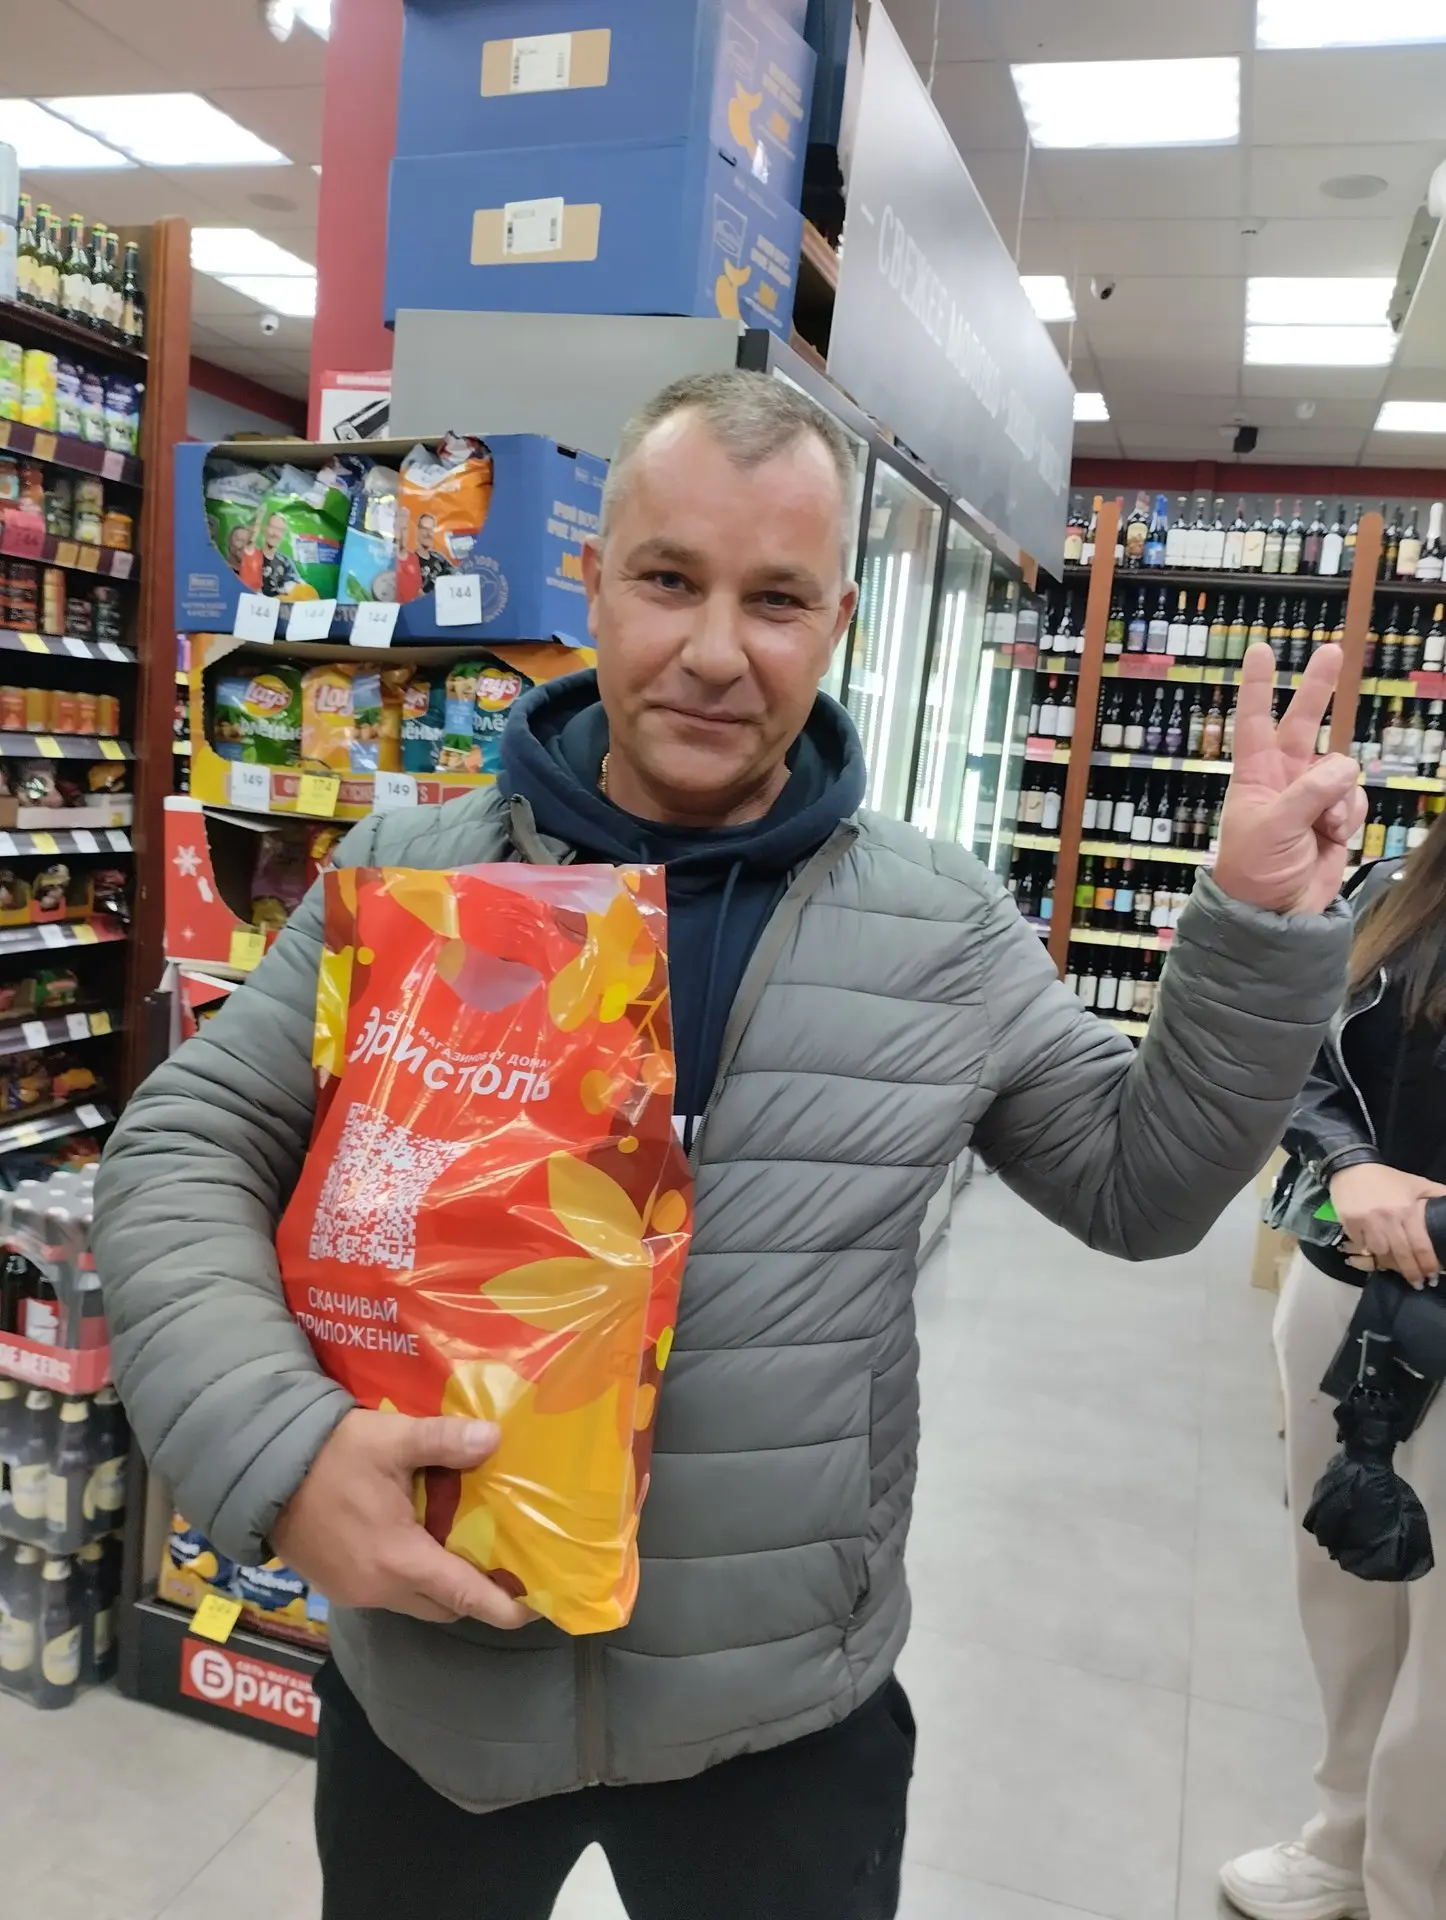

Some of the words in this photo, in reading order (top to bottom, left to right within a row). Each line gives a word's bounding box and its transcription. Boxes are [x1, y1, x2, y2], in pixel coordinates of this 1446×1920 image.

[448, 586, 472, 599] 144
[250, 603, 271, 618] 144
[242, 773, 264, 786] 149
[387, 782, 411, 797] 149
[307, 1286, 398, 1324] СКАЧИВАЙ
[296, 1311, 420, 1357] ПРИЛОЖЕНИЕ
